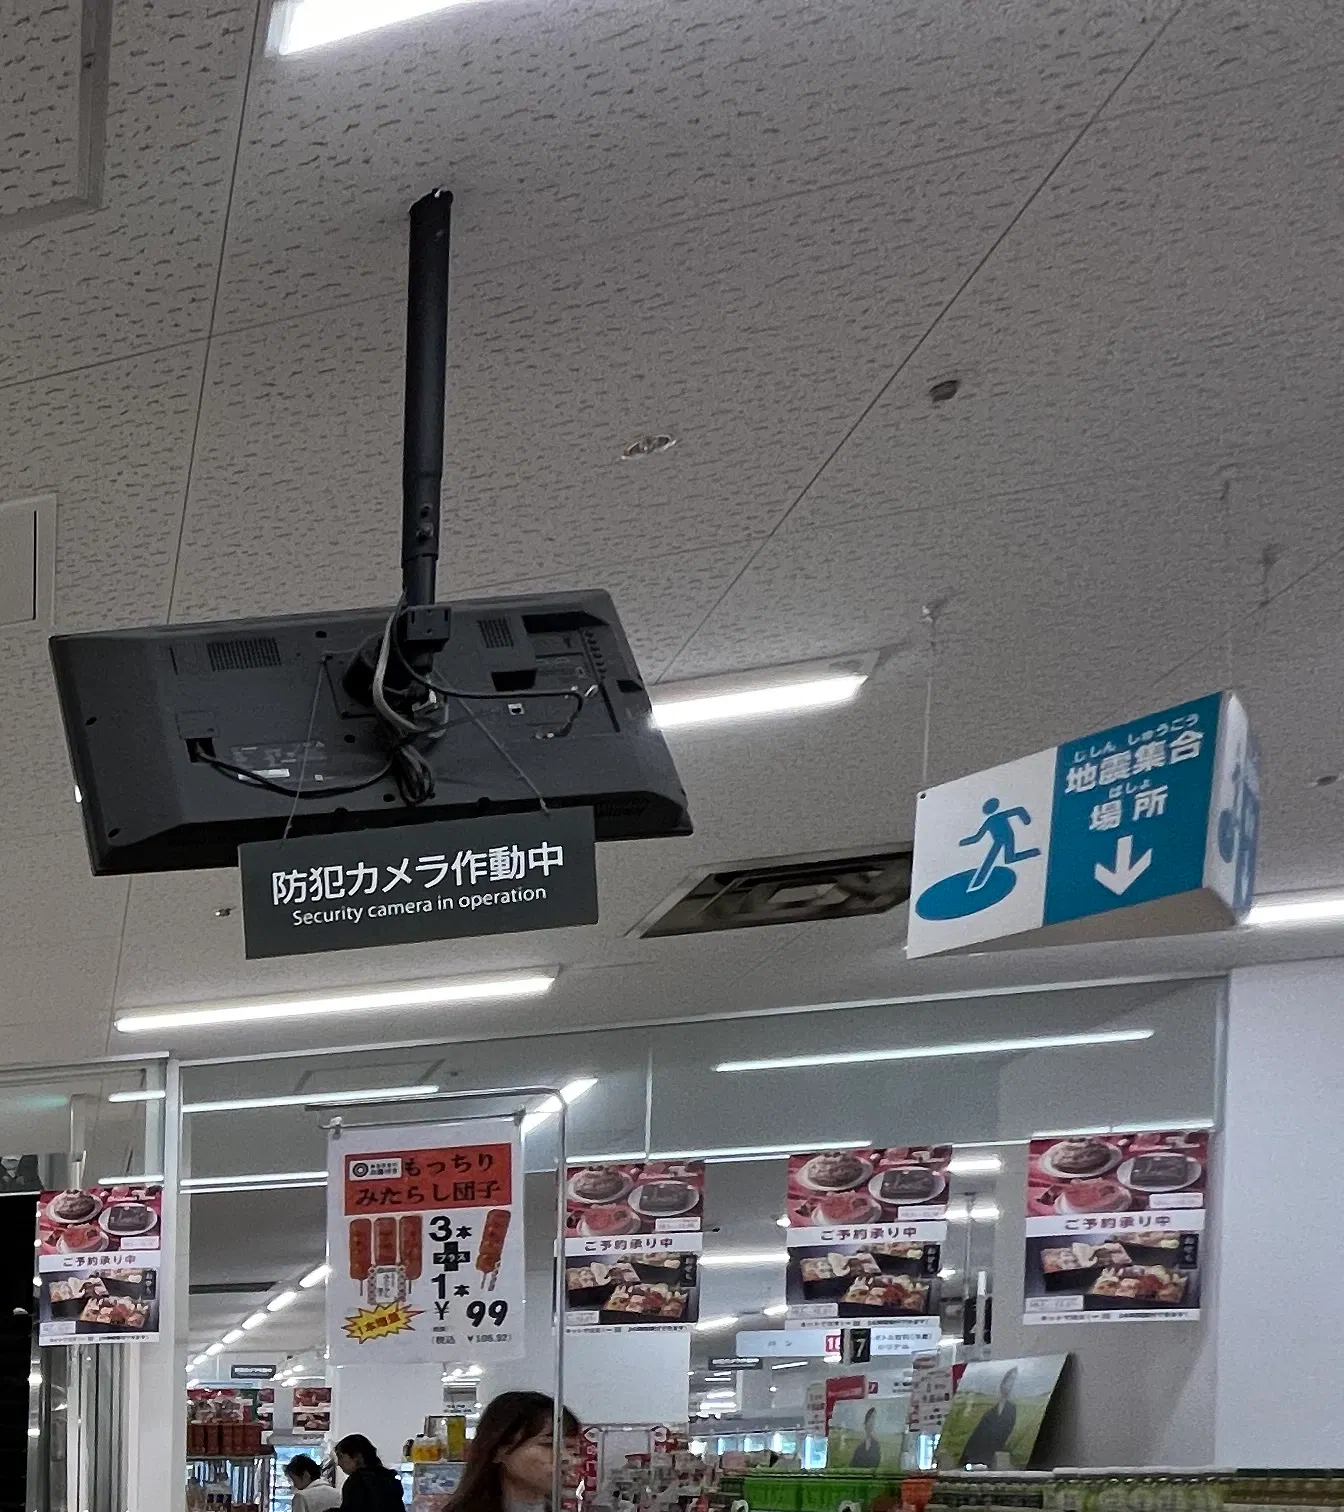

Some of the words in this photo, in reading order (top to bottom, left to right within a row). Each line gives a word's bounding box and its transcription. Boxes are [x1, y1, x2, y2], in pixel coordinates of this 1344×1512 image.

[1065, 730, 1205, 795] 地震集合
[1088, 784, 1168, 831] 場所
[271, 841, 564, 906] 防犯カメラ作動中
[292, 904, 363, 927] Security
[367, 898, 433, 920] camera
[436, 894, 455, 911] in
[458, 885, 548, 911] operation
[404, 1153, 493, 1176] もっちり
[355, 1180, 501, 1206] みたらし団子
[429, 1216, 472, 1242] 3本
[431, 1274, 470, 1299] 1本
